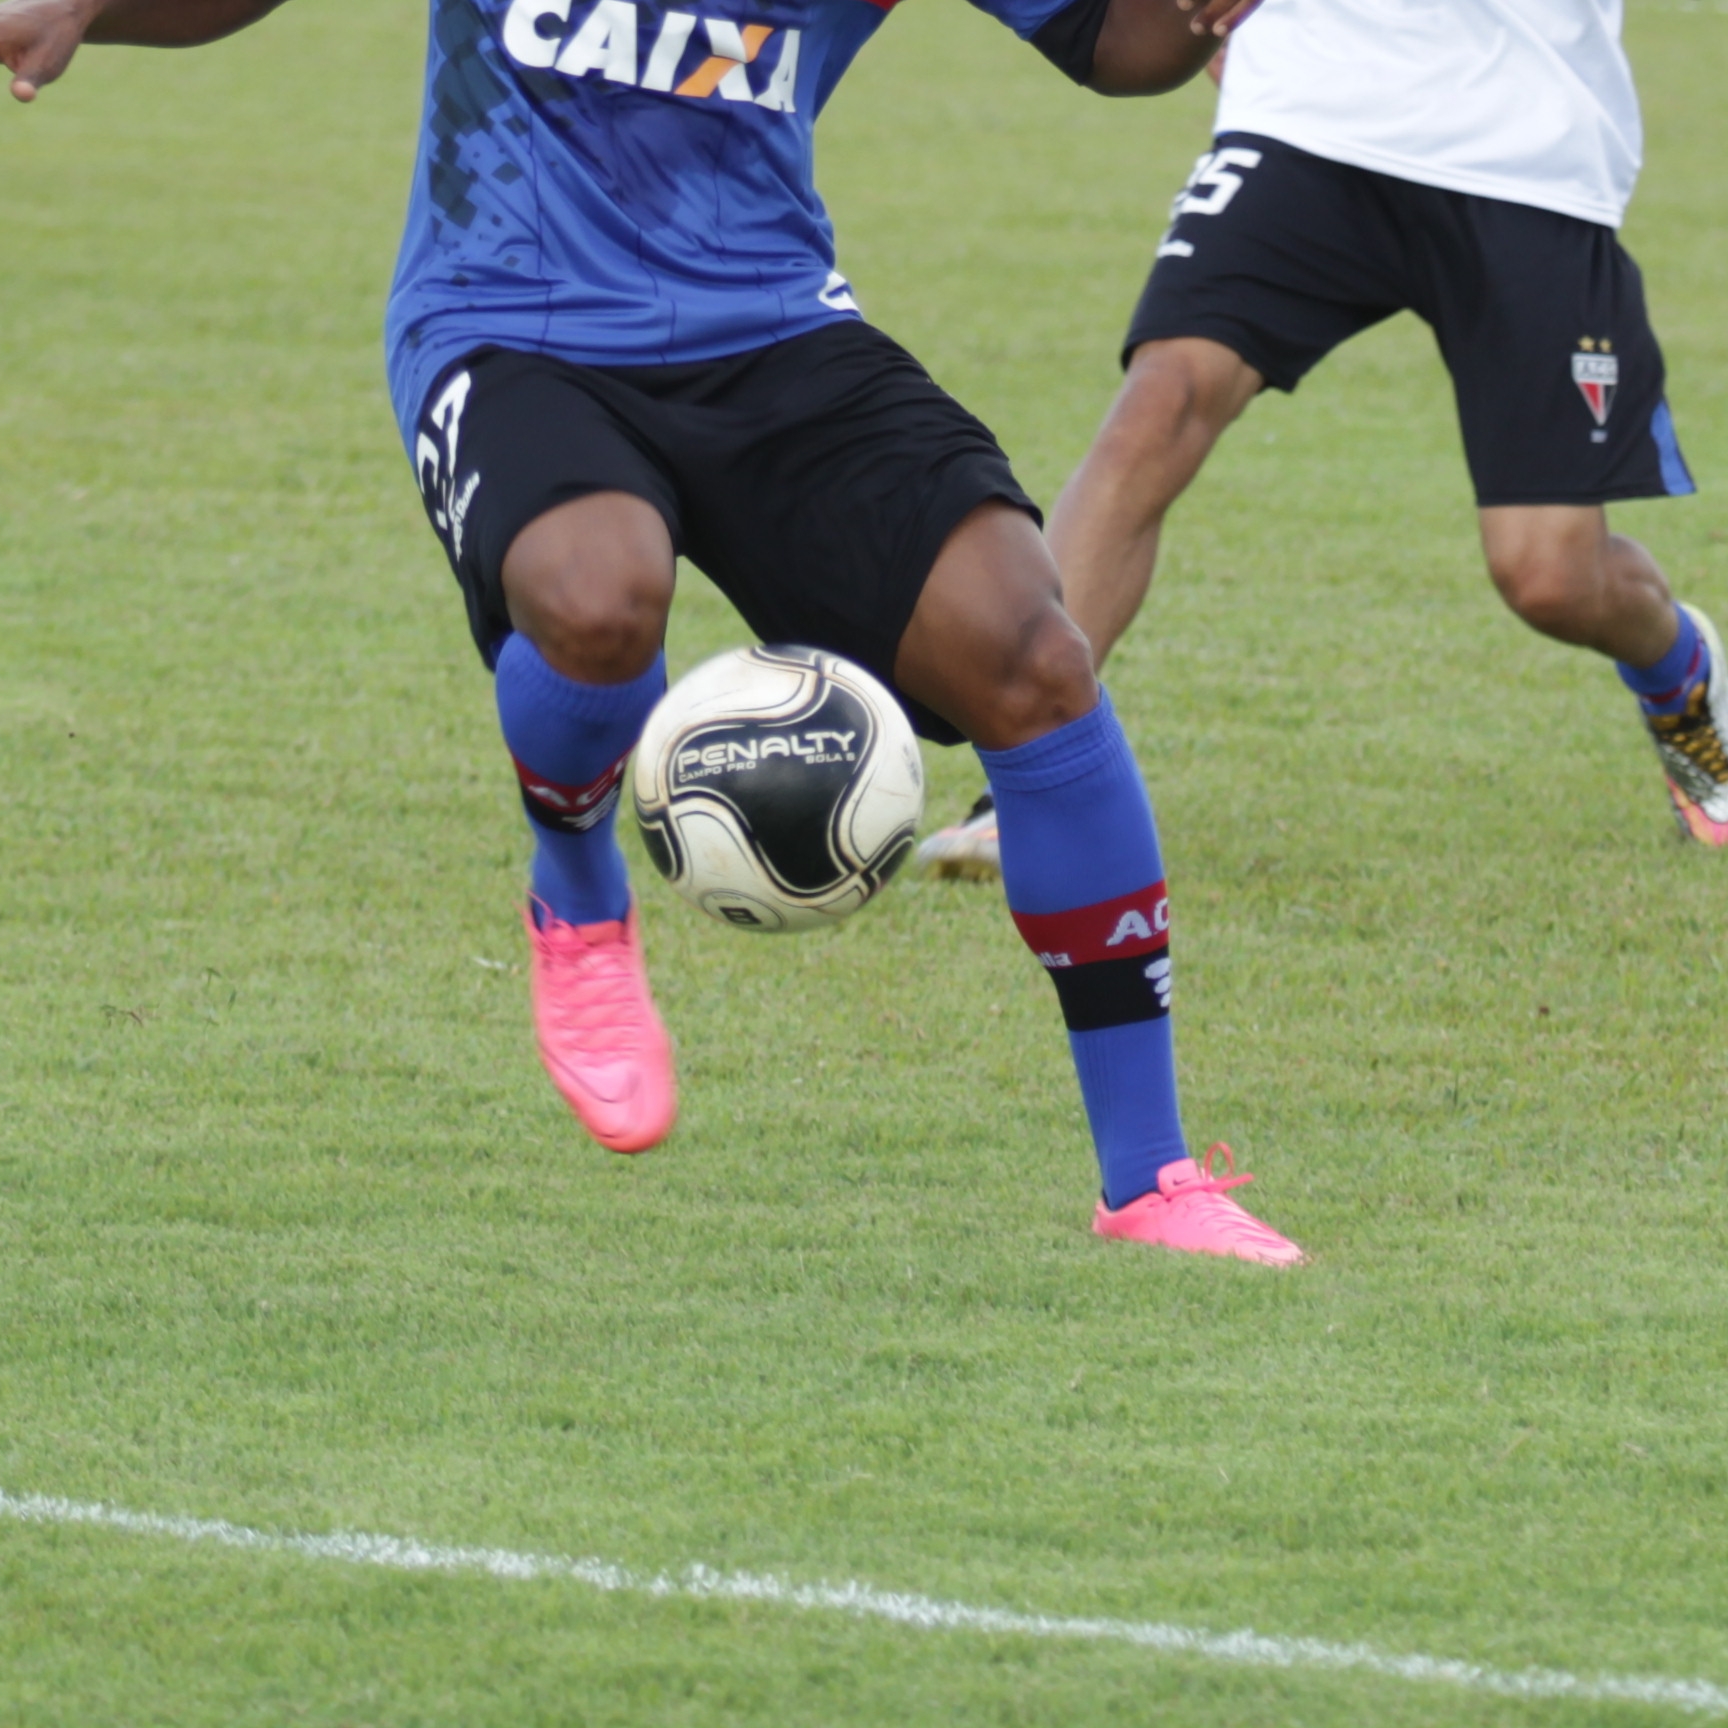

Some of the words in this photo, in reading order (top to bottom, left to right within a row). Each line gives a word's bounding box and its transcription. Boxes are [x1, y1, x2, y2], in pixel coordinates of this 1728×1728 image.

[677, 730, 856, 775] PENALTY
[805, 752, 843, 765] BOLA
[678, 765, 722, 784] CAMPO
[726, 759, 757, 773] PRO
